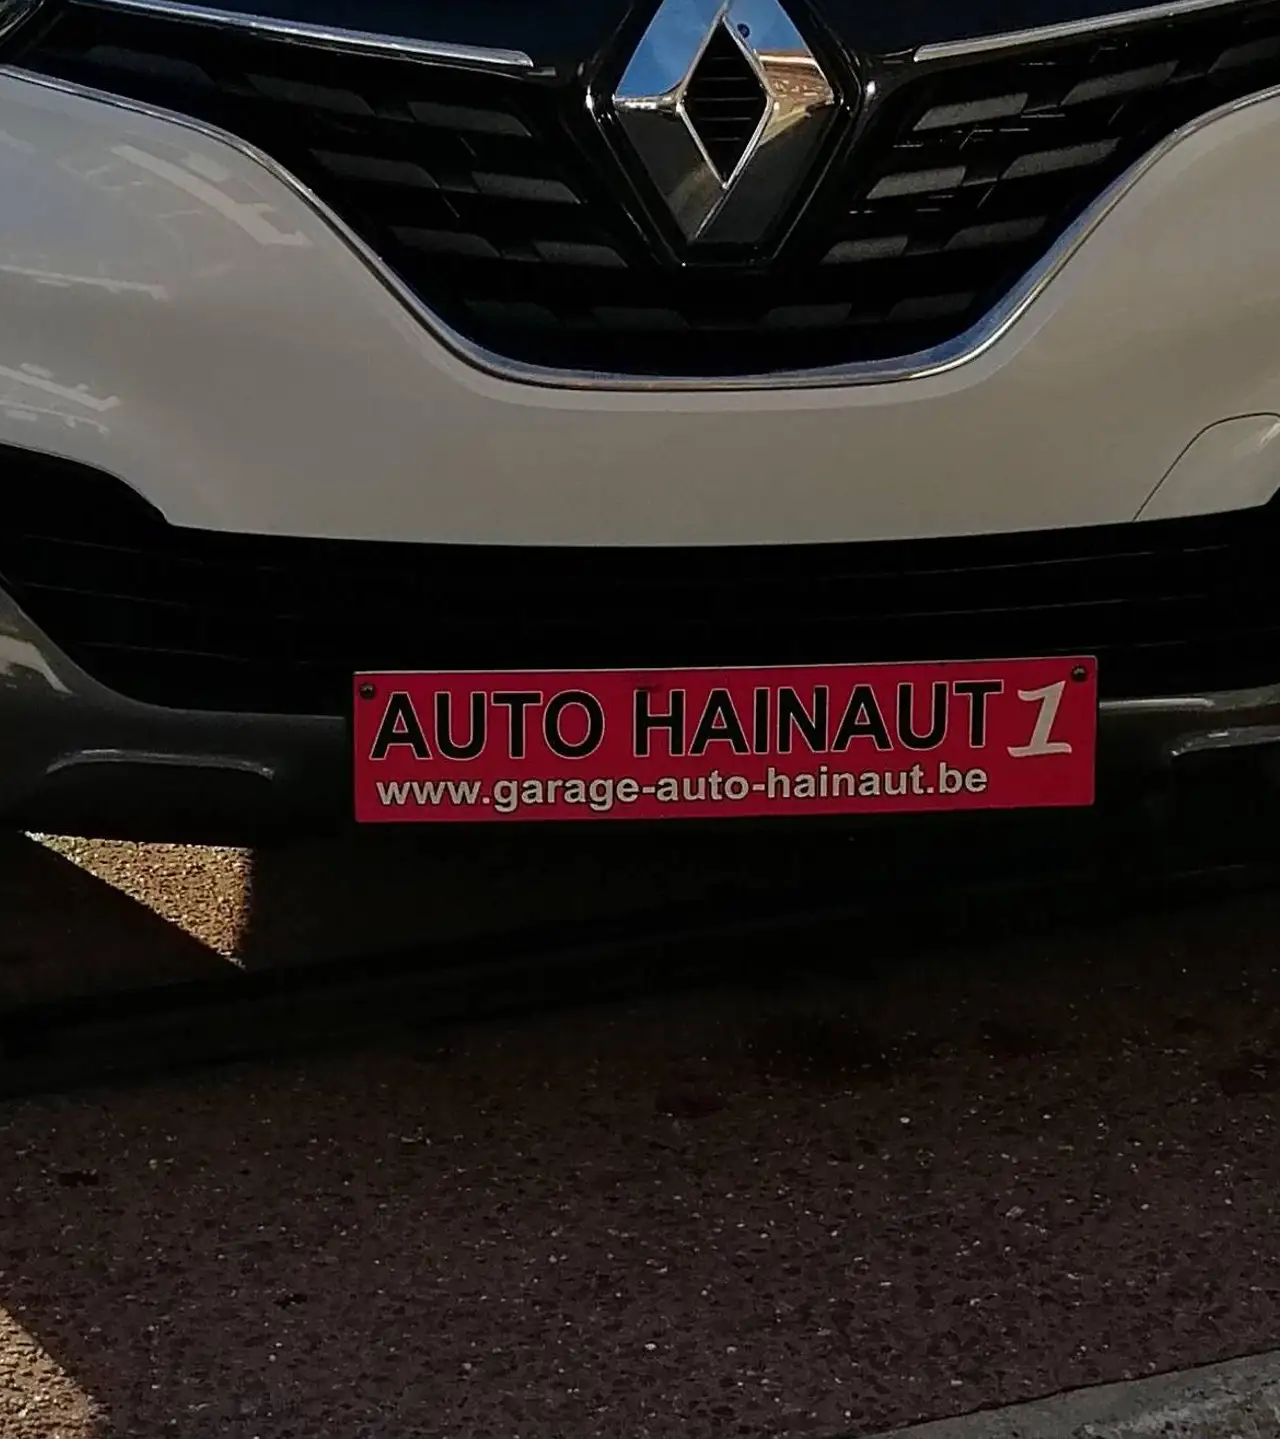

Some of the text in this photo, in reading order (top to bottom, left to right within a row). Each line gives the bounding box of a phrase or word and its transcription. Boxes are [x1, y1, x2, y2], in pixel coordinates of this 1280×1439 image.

[369, 679, 1072, 760] AUTO HAINAUT 1
[376, 762, 989, 813] www.garage-auto-hainaut.be
